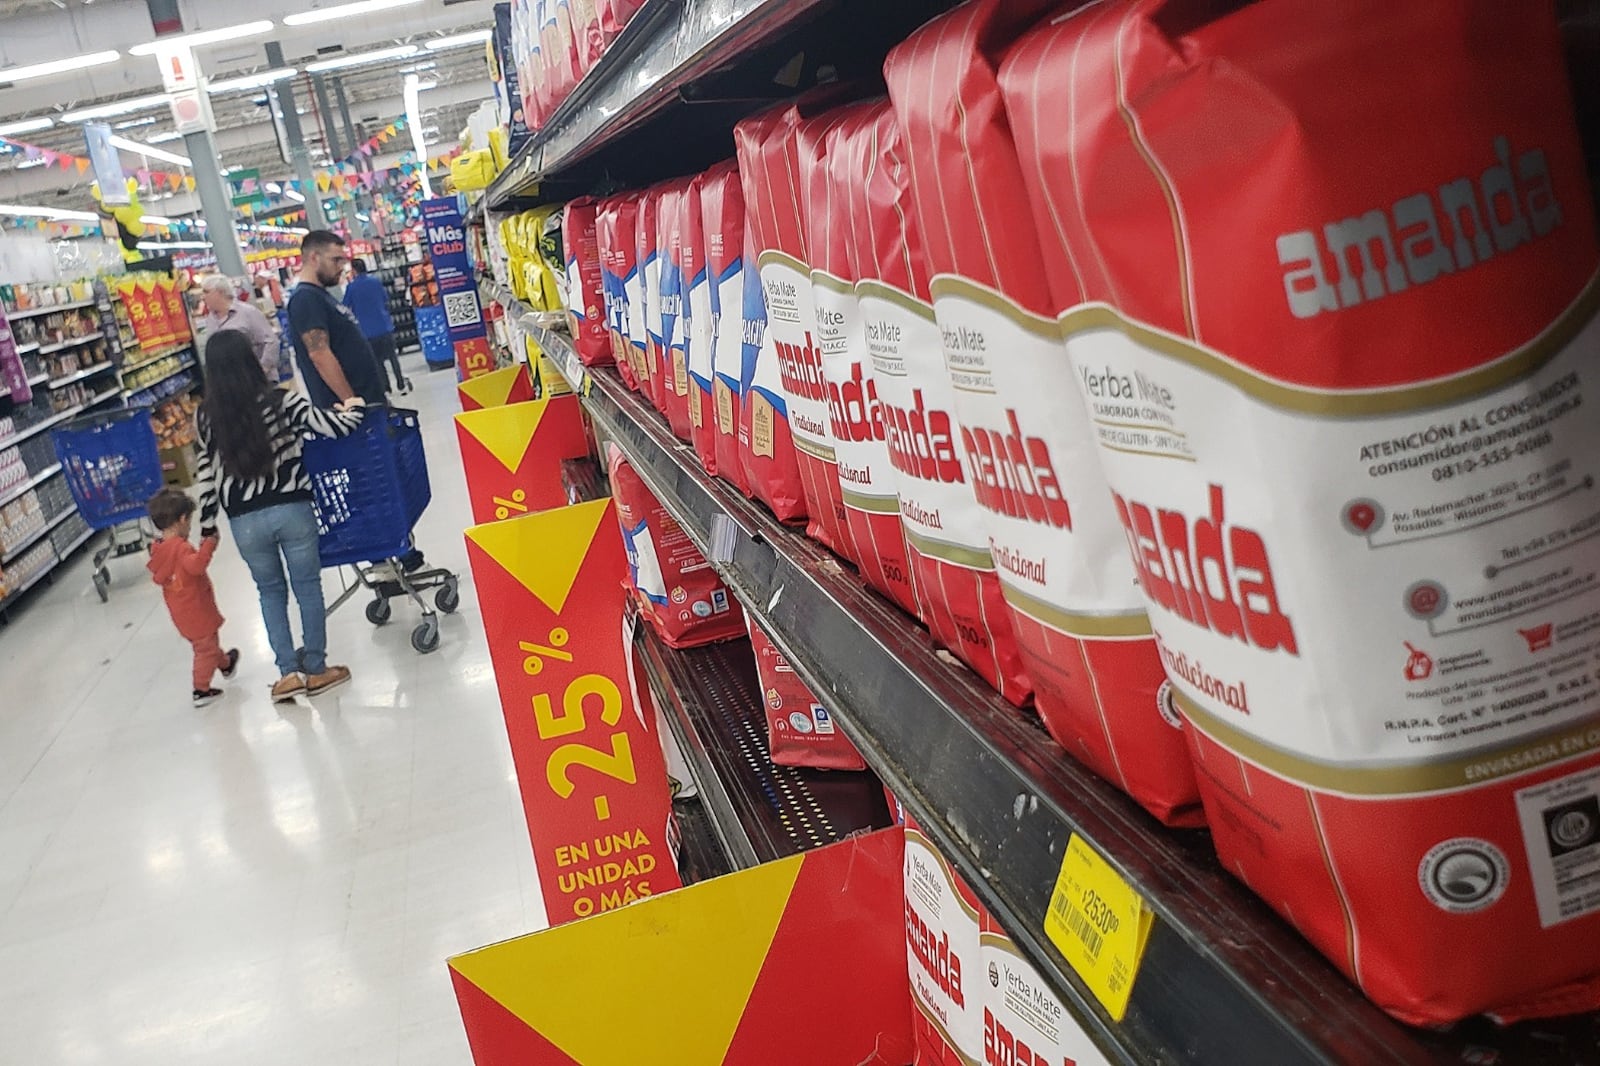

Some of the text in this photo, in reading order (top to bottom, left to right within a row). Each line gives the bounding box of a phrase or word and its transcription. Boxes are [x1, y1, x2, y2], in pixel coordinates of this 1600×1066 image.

[1275, 134, 1563, 319] amanda
[433, 241, 463, 256] Club
[879, 321, 901, 342] Mate
[959, 327, 986, 352] Mate
[1078, 364, 1133, 400] Yerba
[1359, 424, 1455, 461] ATENCIÓN
[1458, 418, 1481, 436] AL
[1154, 629, 1251, 716] Tradicional
[518, 626, 637, 821] -25%
[1463, 742, 1560, 781] ENVASADA
[553, 827, 651, 868] EN UNA
[557, 853, 657, 895] UNIDAD
[572, 881, 653, 918] O MÁS
[1002, 963, 1062, 1020] Yerba Mate
